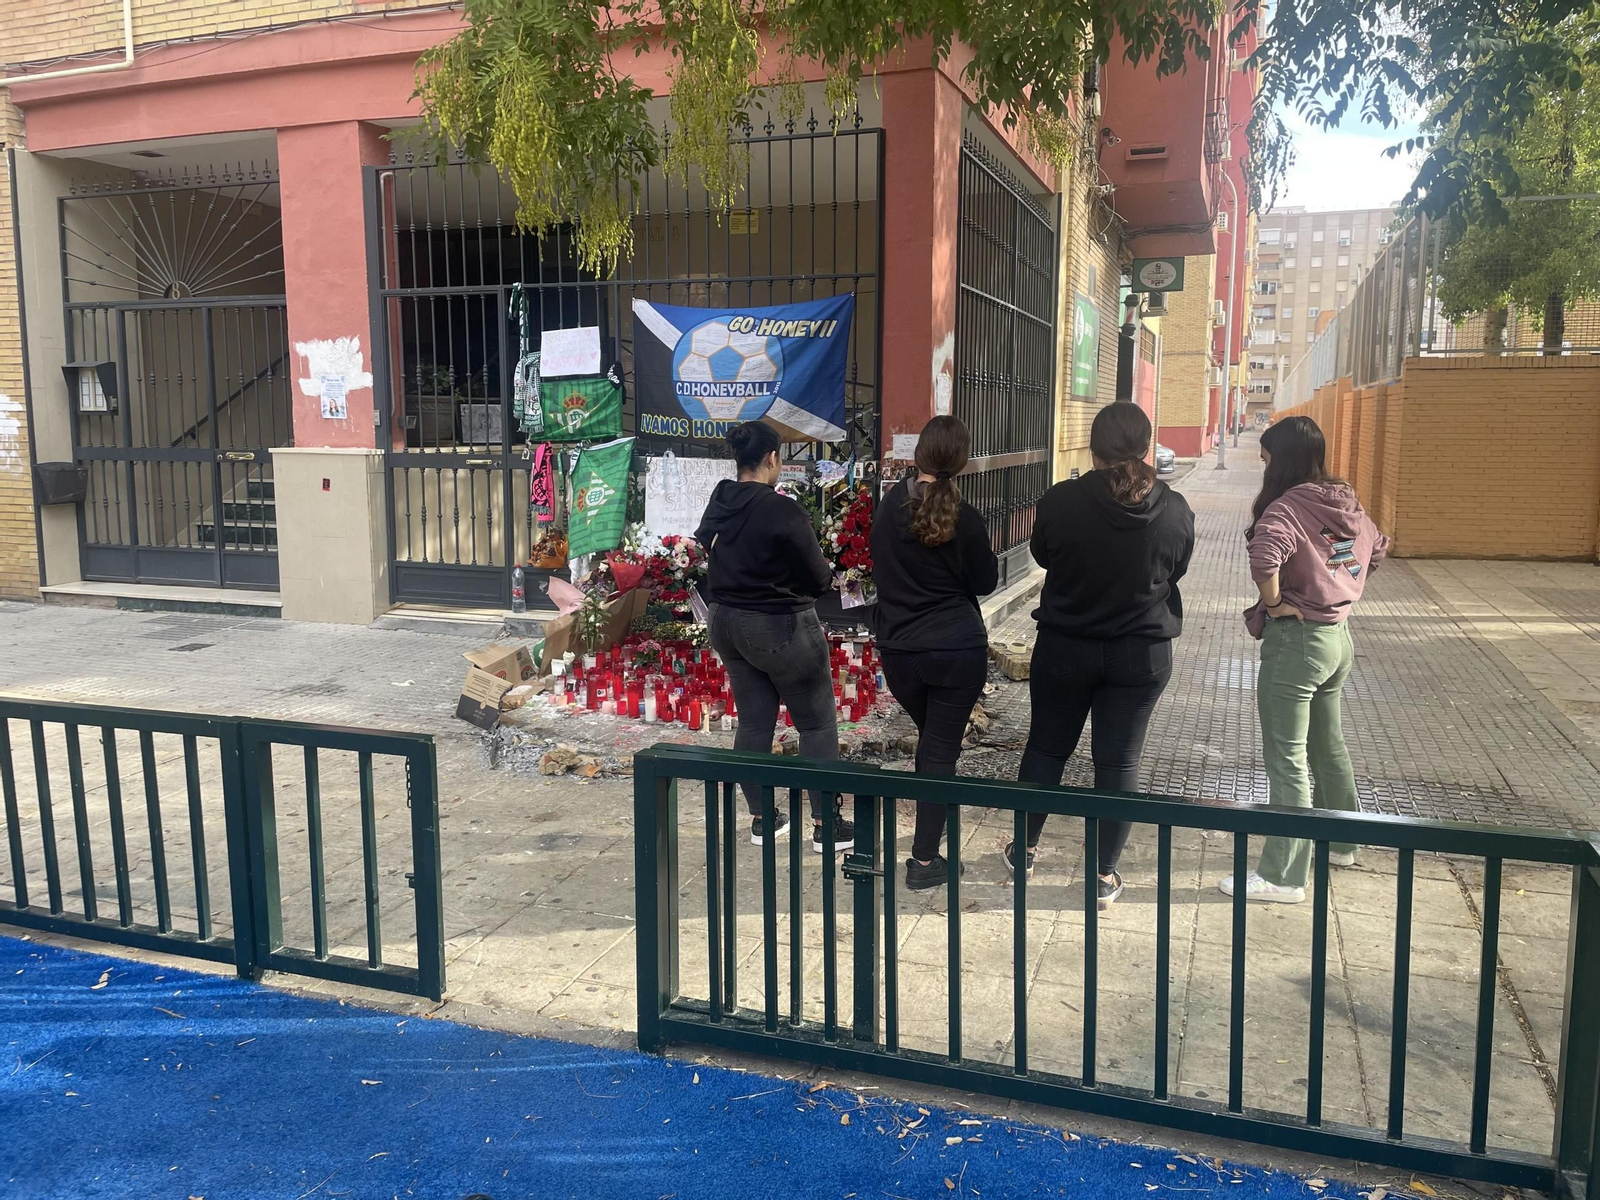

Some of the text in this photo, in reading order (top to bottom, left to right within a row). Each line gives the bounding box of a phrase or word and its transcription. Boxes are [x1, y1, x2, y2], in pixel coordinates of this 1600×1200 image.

[172, 282, 181, 300] 8
[728, 316, 755, 333] GO
[692, 418, 740, 439] HON
[716, 460, 736, 476] EN
[677, 476, 708, 494] PAZ
[665, 492, 711, 511] SAND
